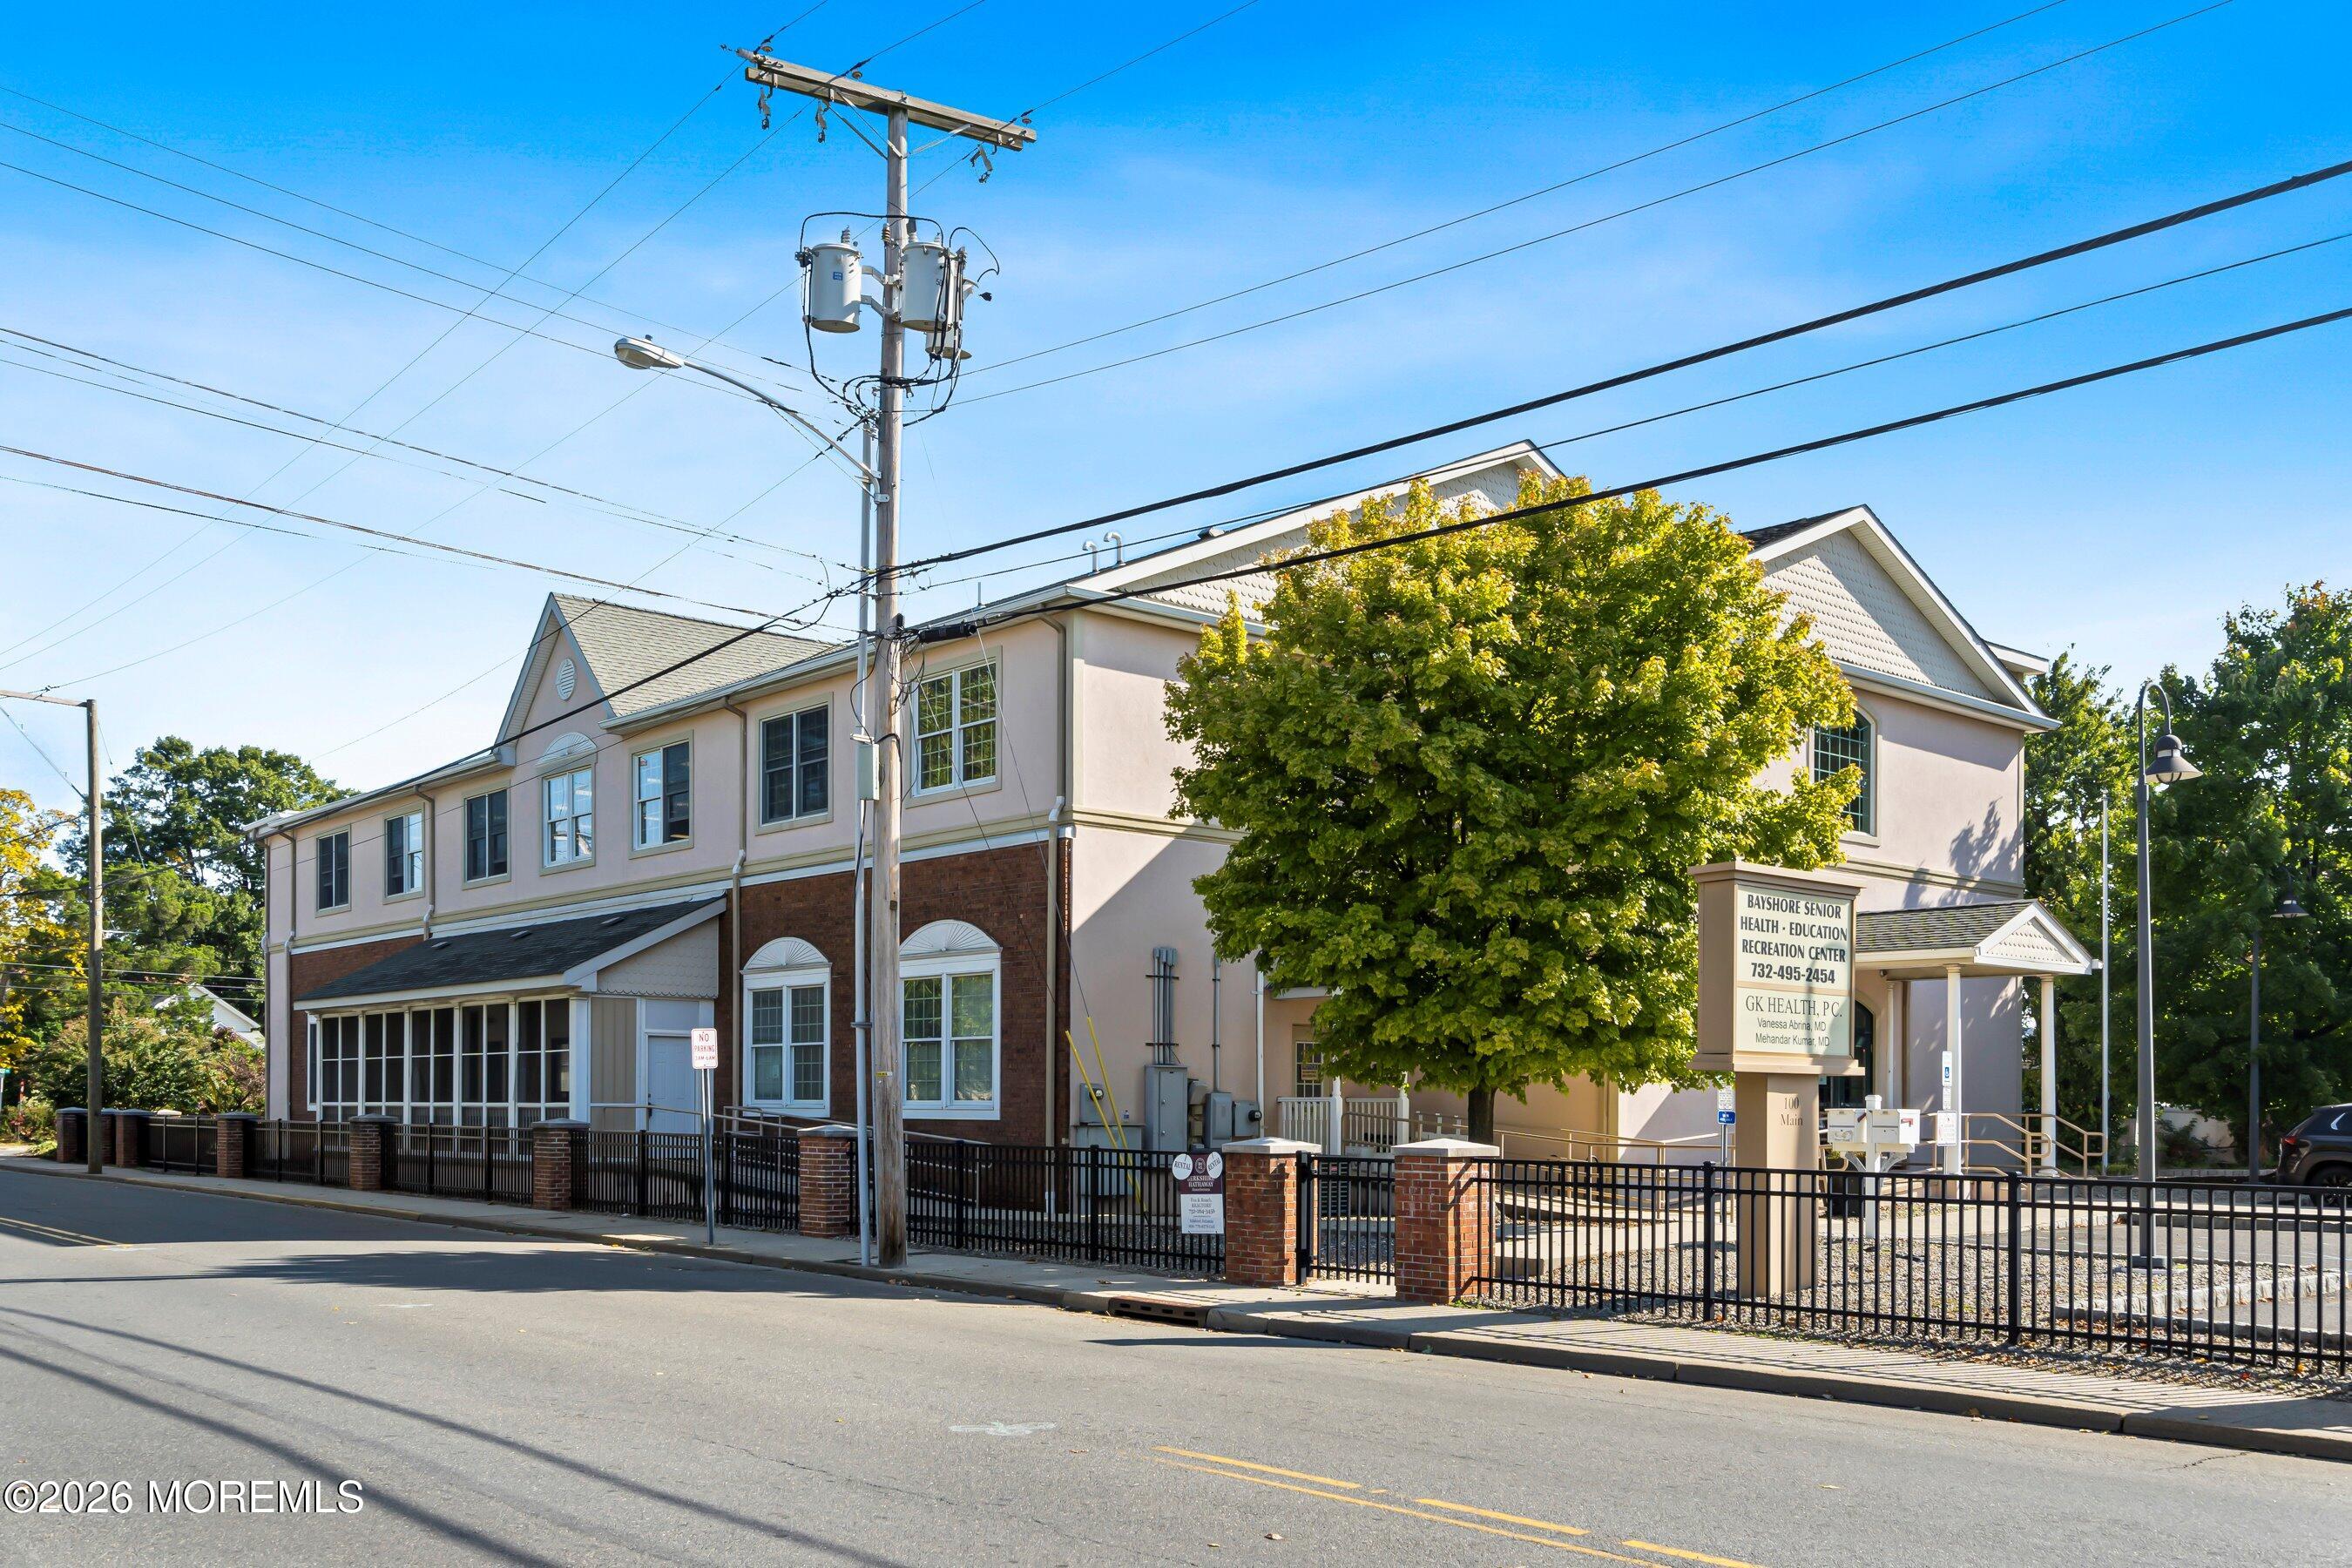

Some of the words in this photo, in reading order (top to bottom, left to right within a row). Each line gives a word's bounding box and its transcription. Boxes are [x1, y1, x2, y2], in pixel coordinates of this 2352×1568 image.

[1747, 894, 1801, 914] BAYSHORE
[1804, 902, 1842, 919] SENIOR
[1740, 916, 1779, 934] HEALTH
[1789, 922, 1848, 941] EDUCATION
[1741, 939, 1805, 959] RECREATION
[1808, 946, 1846, 963] CENTER
[1751, 963, 1835, 983] 732-495-2454
[1746, 995, 1764, 1012] GK
[1767, 997, 1820, 1017] HEALTH,
[1757, 1017, 1788, 1029] Vanessa
[1815, 1022, 1827, 1031] MD
[699, 1033, 710, 1042] NO
[1755, 1033, 1791, 1044] Mehandar
[1793, 1035, 1816, 1046] Kumar,
[1818, 1037, 1830, 1047] MD
[1784, 1097, 1800, 1110] 100
[1781, 1113, 1803, 1126] Main
[1174, 1160, 1192, 1171] RENTAL
[1207, 1157, 1221, 1172] RENTAL
